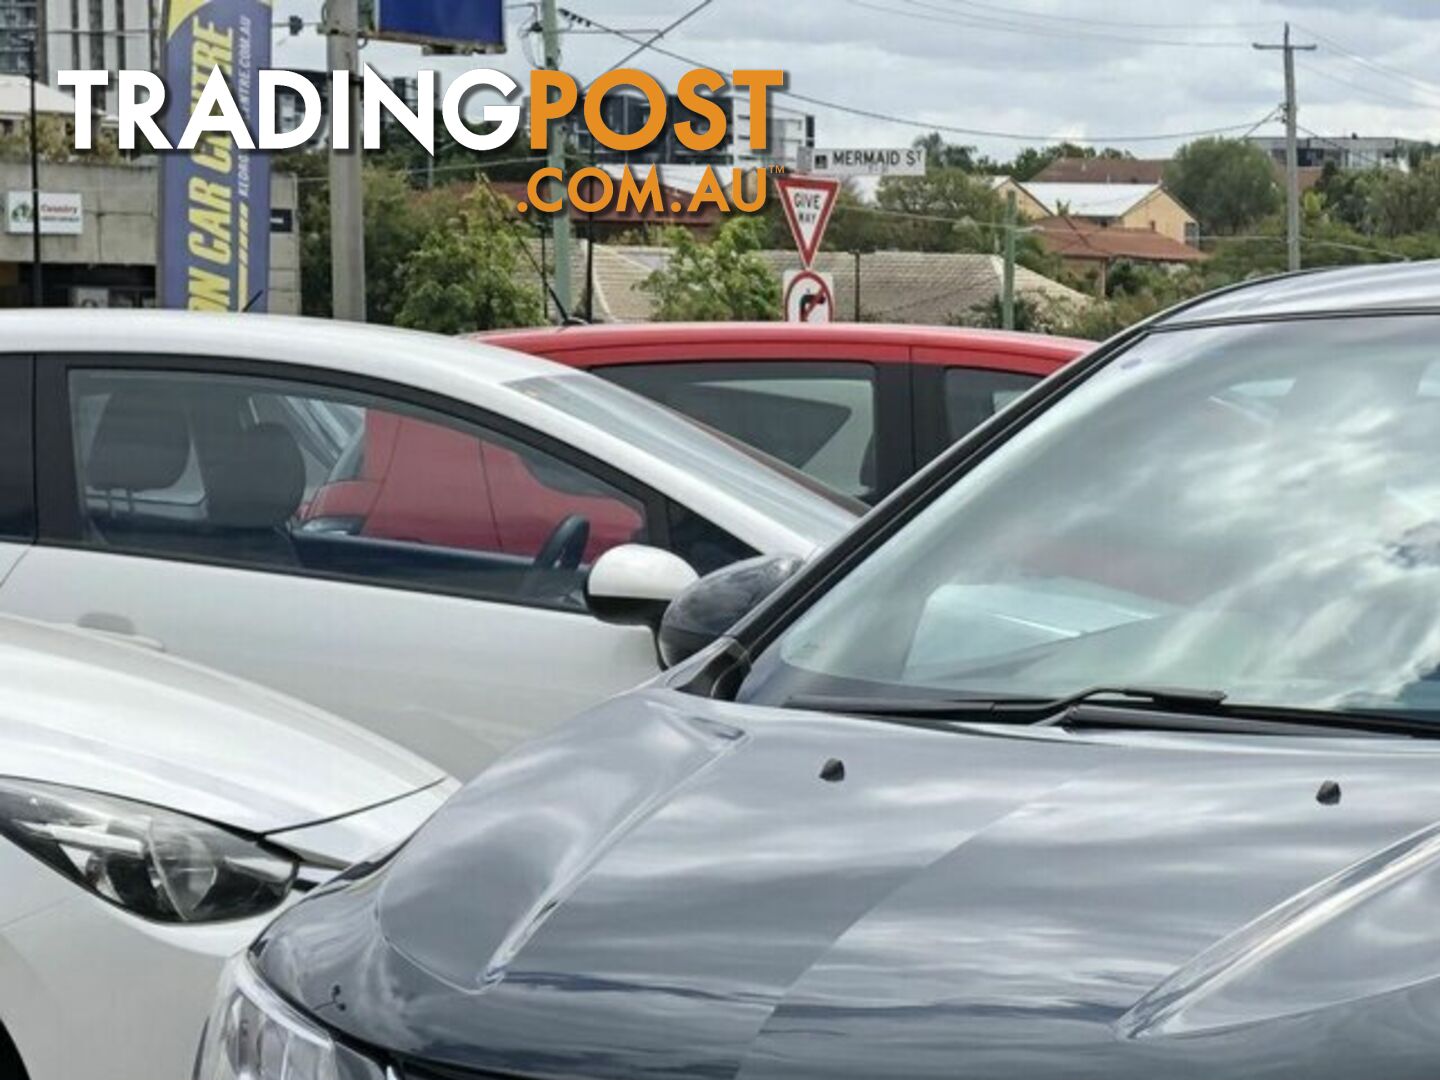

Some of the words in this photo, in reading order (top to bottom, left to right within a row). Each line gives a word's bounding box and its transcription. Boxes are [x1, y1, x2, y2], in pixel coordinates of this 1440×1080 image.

[832, 150, 900, 166] MERMAID
[794, 193, 820, 209] GIVE
[187, 176, 232, 264] CAR
